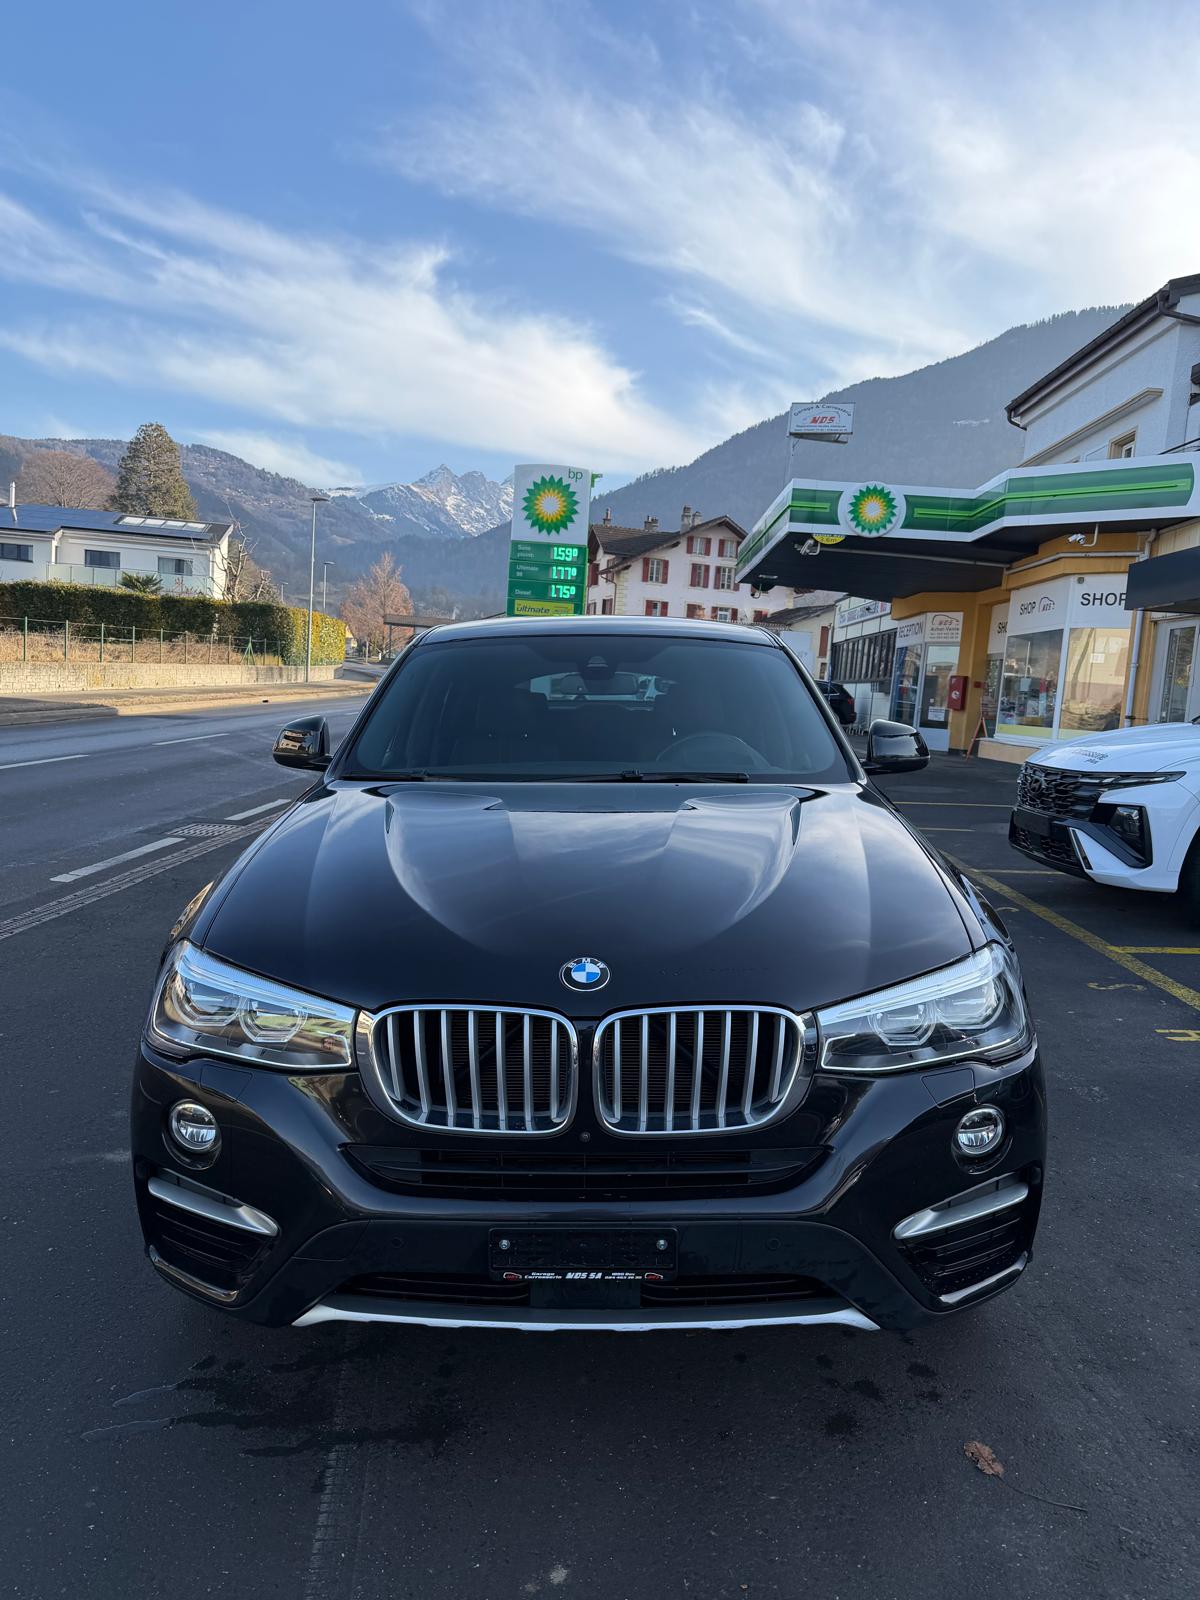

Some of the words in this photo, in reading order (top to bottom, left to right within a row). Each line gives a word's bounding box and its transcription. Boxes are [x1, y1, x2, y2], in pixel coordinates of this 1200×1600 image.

[809, 416, 836, 424] NDS
[568, 468, 584, 482] bp
[1019, 601, 1036, 615] SHOP
[566, 957, 607, 969] BMW
